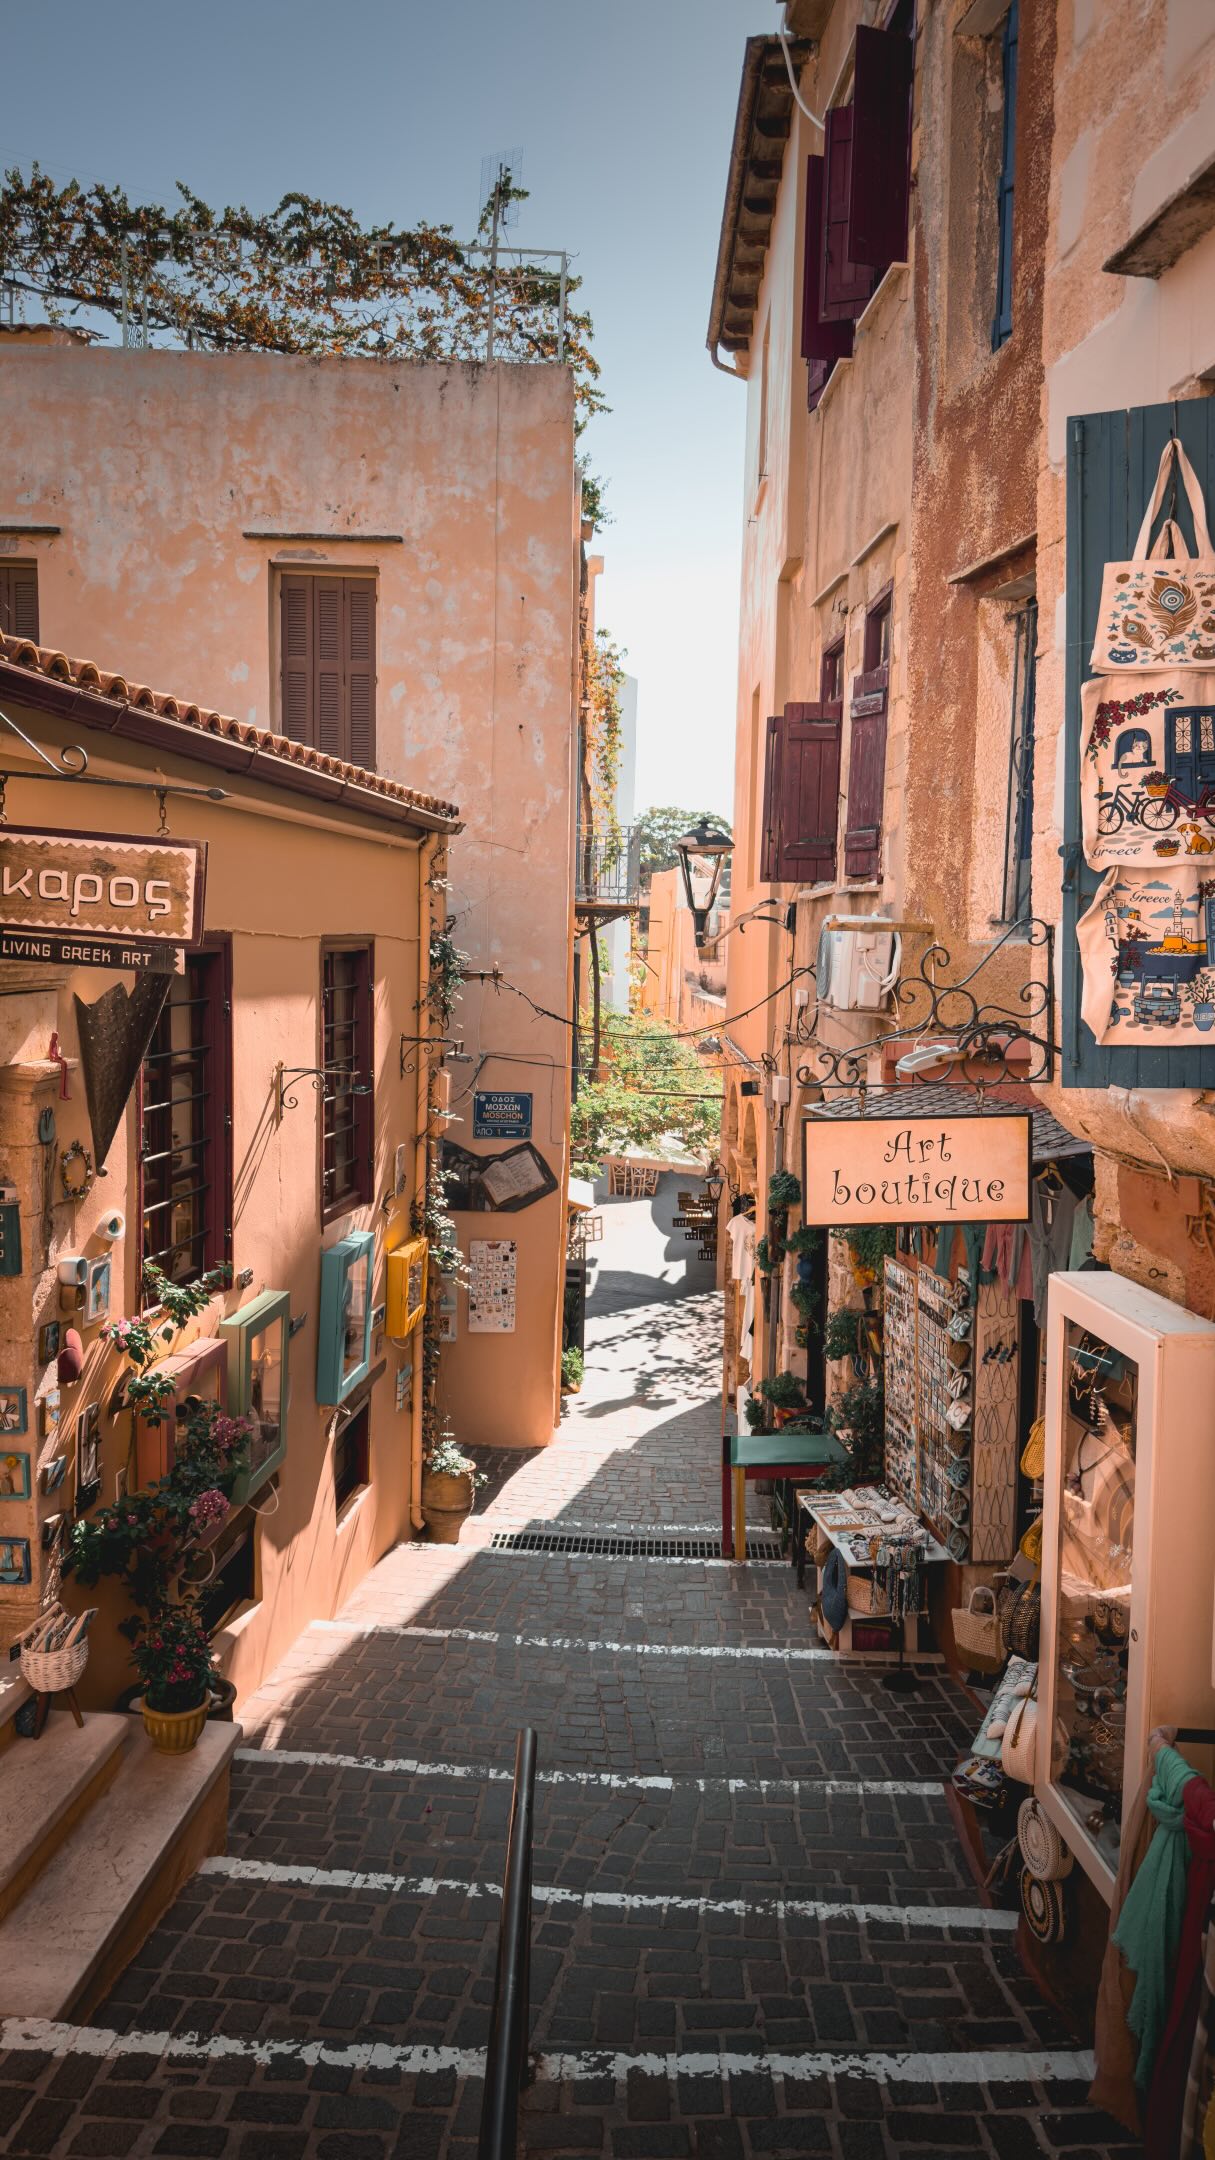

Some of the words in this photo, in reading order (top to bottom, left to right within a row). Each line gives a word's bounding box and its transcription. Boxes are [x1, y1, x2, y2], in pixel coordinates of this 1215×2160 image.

[1092, 844, 1143, 859] Greece
[1129, 889, 1172, 904] Greece
[2, 940, 51, 957] LIVING
[62, 946, 111, 962] GREEK
[122, 952, 152, 966] ART
[883, 1130, 952, 1163] Art
[831, 1168, 1005, 1211] boutique
